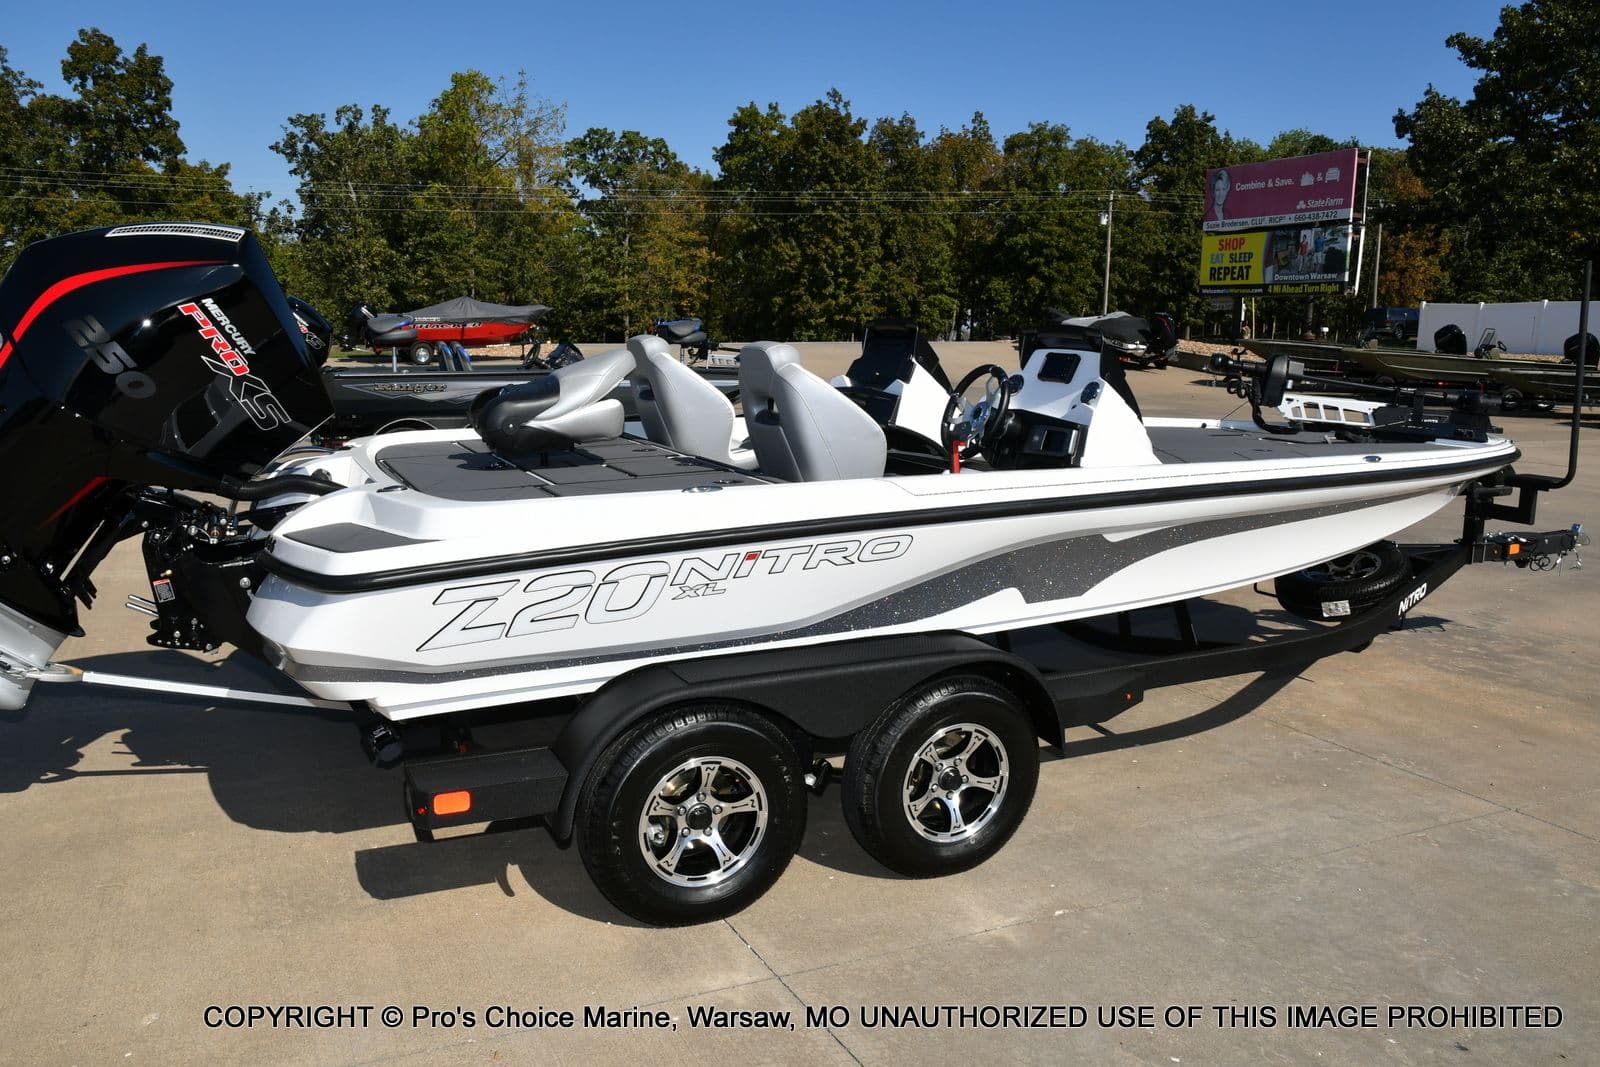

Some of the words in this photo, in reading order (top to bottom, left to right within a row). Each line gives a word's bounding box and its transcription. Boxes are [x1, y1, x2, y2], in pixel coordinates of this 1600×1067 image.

[1235, 180, 1265, 191] Combine
[1267, 178, 1273, 188] &
[1275, 177, 1294, 187] Save.
[1317, 172, 1323, 182] &
[1294, 210, 1338, 221] 660-438-7472
[1218, 238, 1245, 251] SHOP
[1210, 253, 1224, 263] EAT
[1229, 252, 1253, 264] SLEEP
[1209, 265, 1251, 281] REPEAT
[1274, 273, 1309, 281] Downtown
[1310, 272, 1338, 280] Warsaw
[1267, 285, 1272, 293] 4
[1273, 285, 1281, 293] Mi
[1282, 284, 1303, 293] Ahead
[1304, 284, 1319, 293] Turn
[1320, 283, 1339, 293] Right
[201, 298, 256, 355] MERCURY
[178, 302, 250, 376] PRO
[62, 314, 157, 399] 250
[200, 355, 292, 431] XS
[671, 583, 728, 601] XL
[416, 560, 671, 652] Z20
